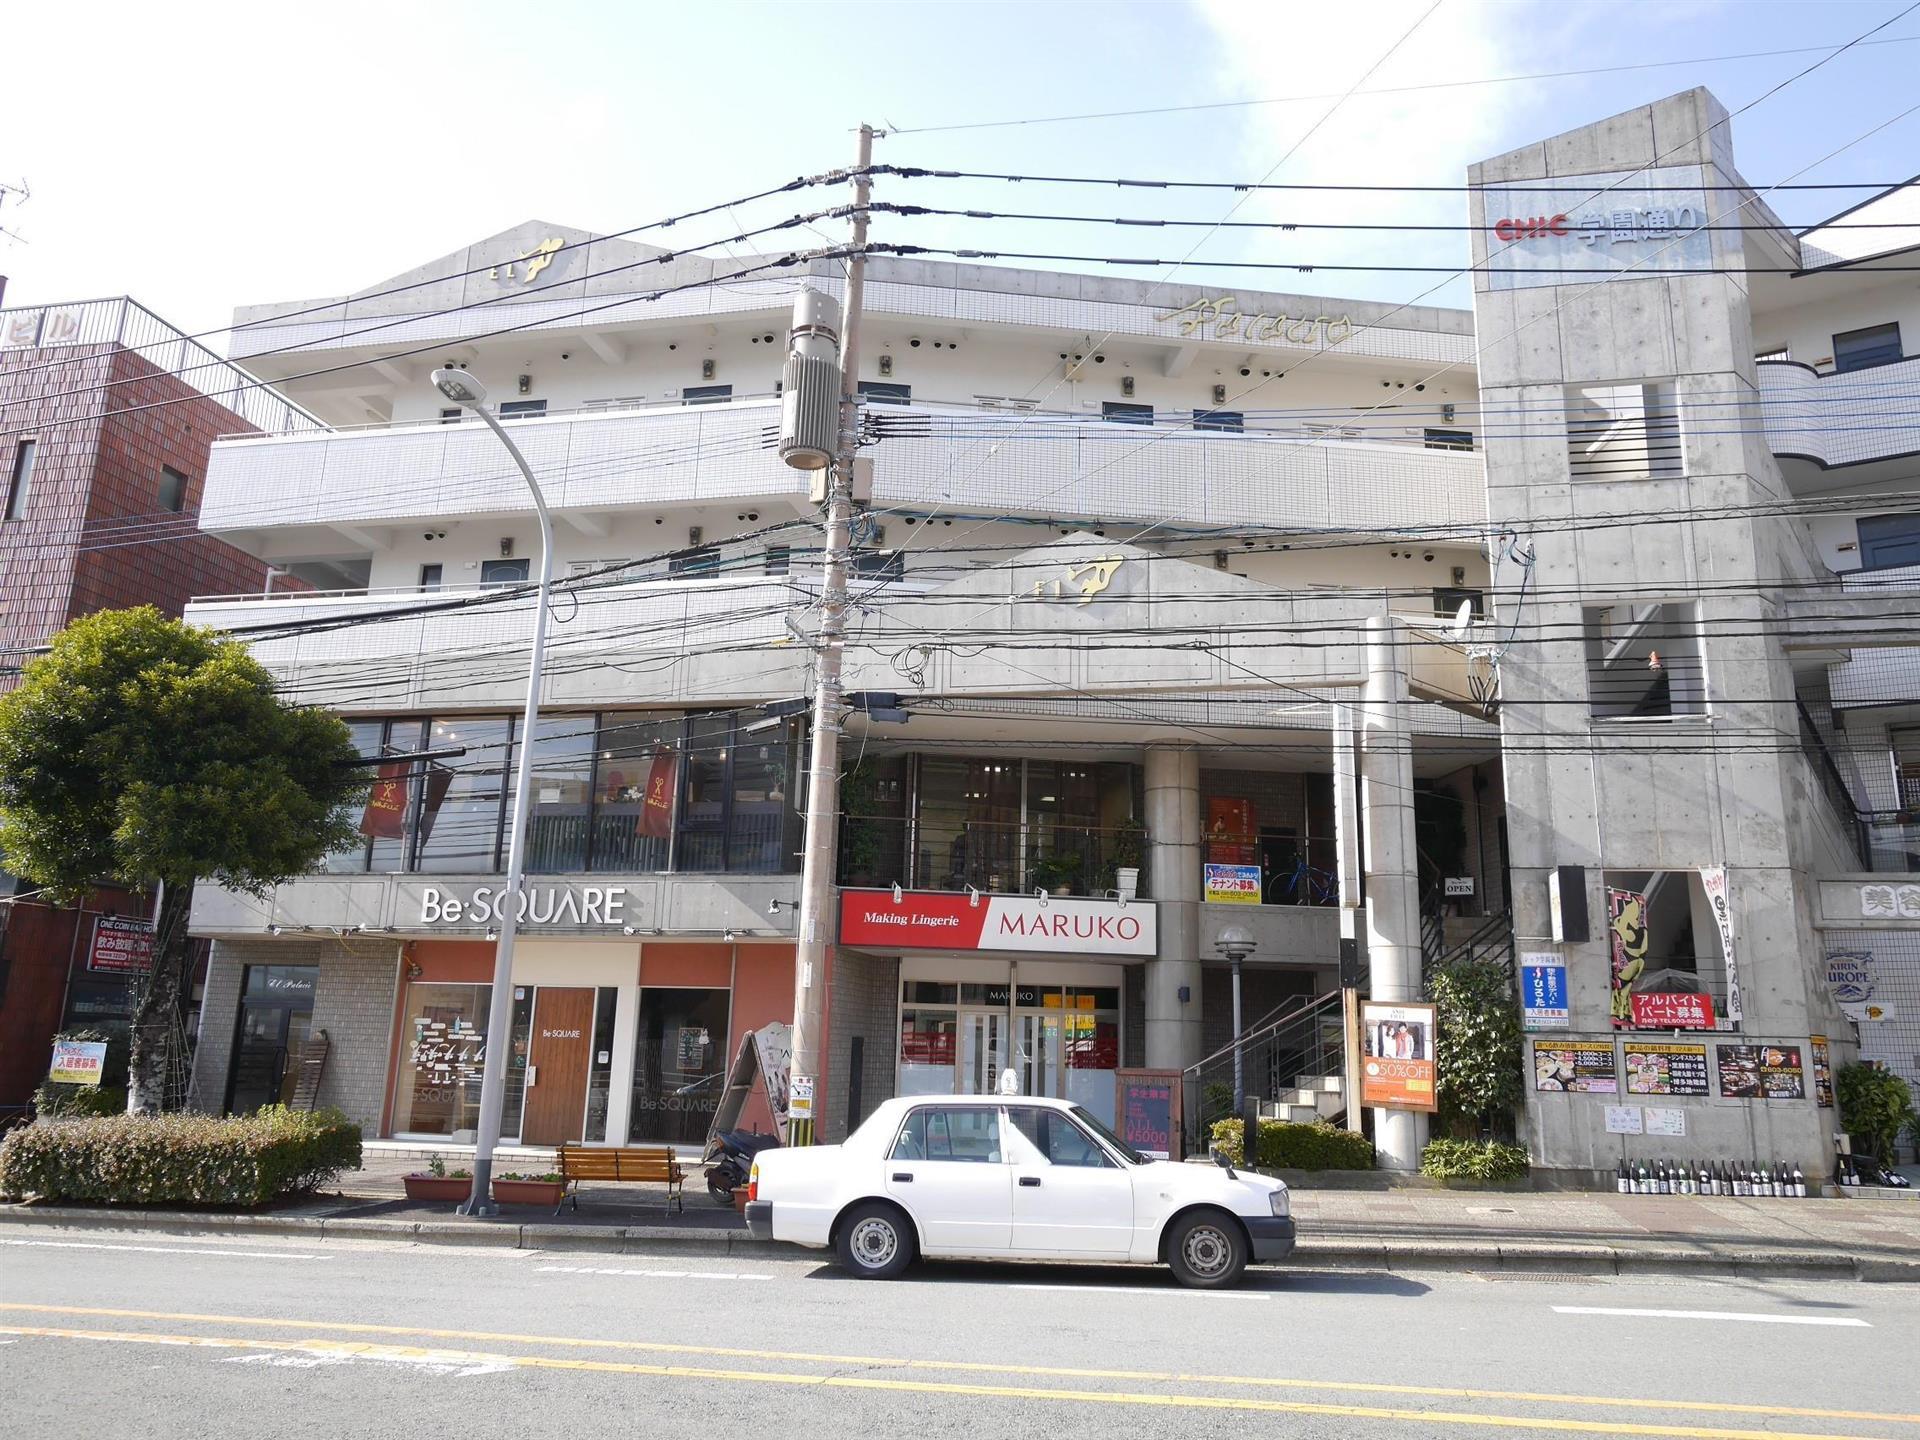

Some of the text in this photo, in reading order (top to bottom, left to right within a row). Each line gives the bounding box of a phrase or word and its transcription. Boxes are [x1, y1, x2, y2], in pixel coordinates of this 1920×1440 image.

[1576, 206, 1696, 247] 学園通り
[9, 313, 77, 343] ビル
[1211, 879, 1255, 892] テナント募集
[100, 920, 114, 928] ONE
[114, 922, 129, 931] COIN
[864, 912, 960, 927] Making Lingerie
[1000, 913, 1140, 940] MARUKO
[1830, 963, 1859, 971] KIRIN
[1828, 972, 1870, 983] UROPE
[1533, 979, 1546, 1007] ひろた
[1637, 995, 1701, 1006] アルバイト
[1641, 1006, 1705, 1018] パート募集
[1379, 1064, 1432, 1079] 50%OFF
